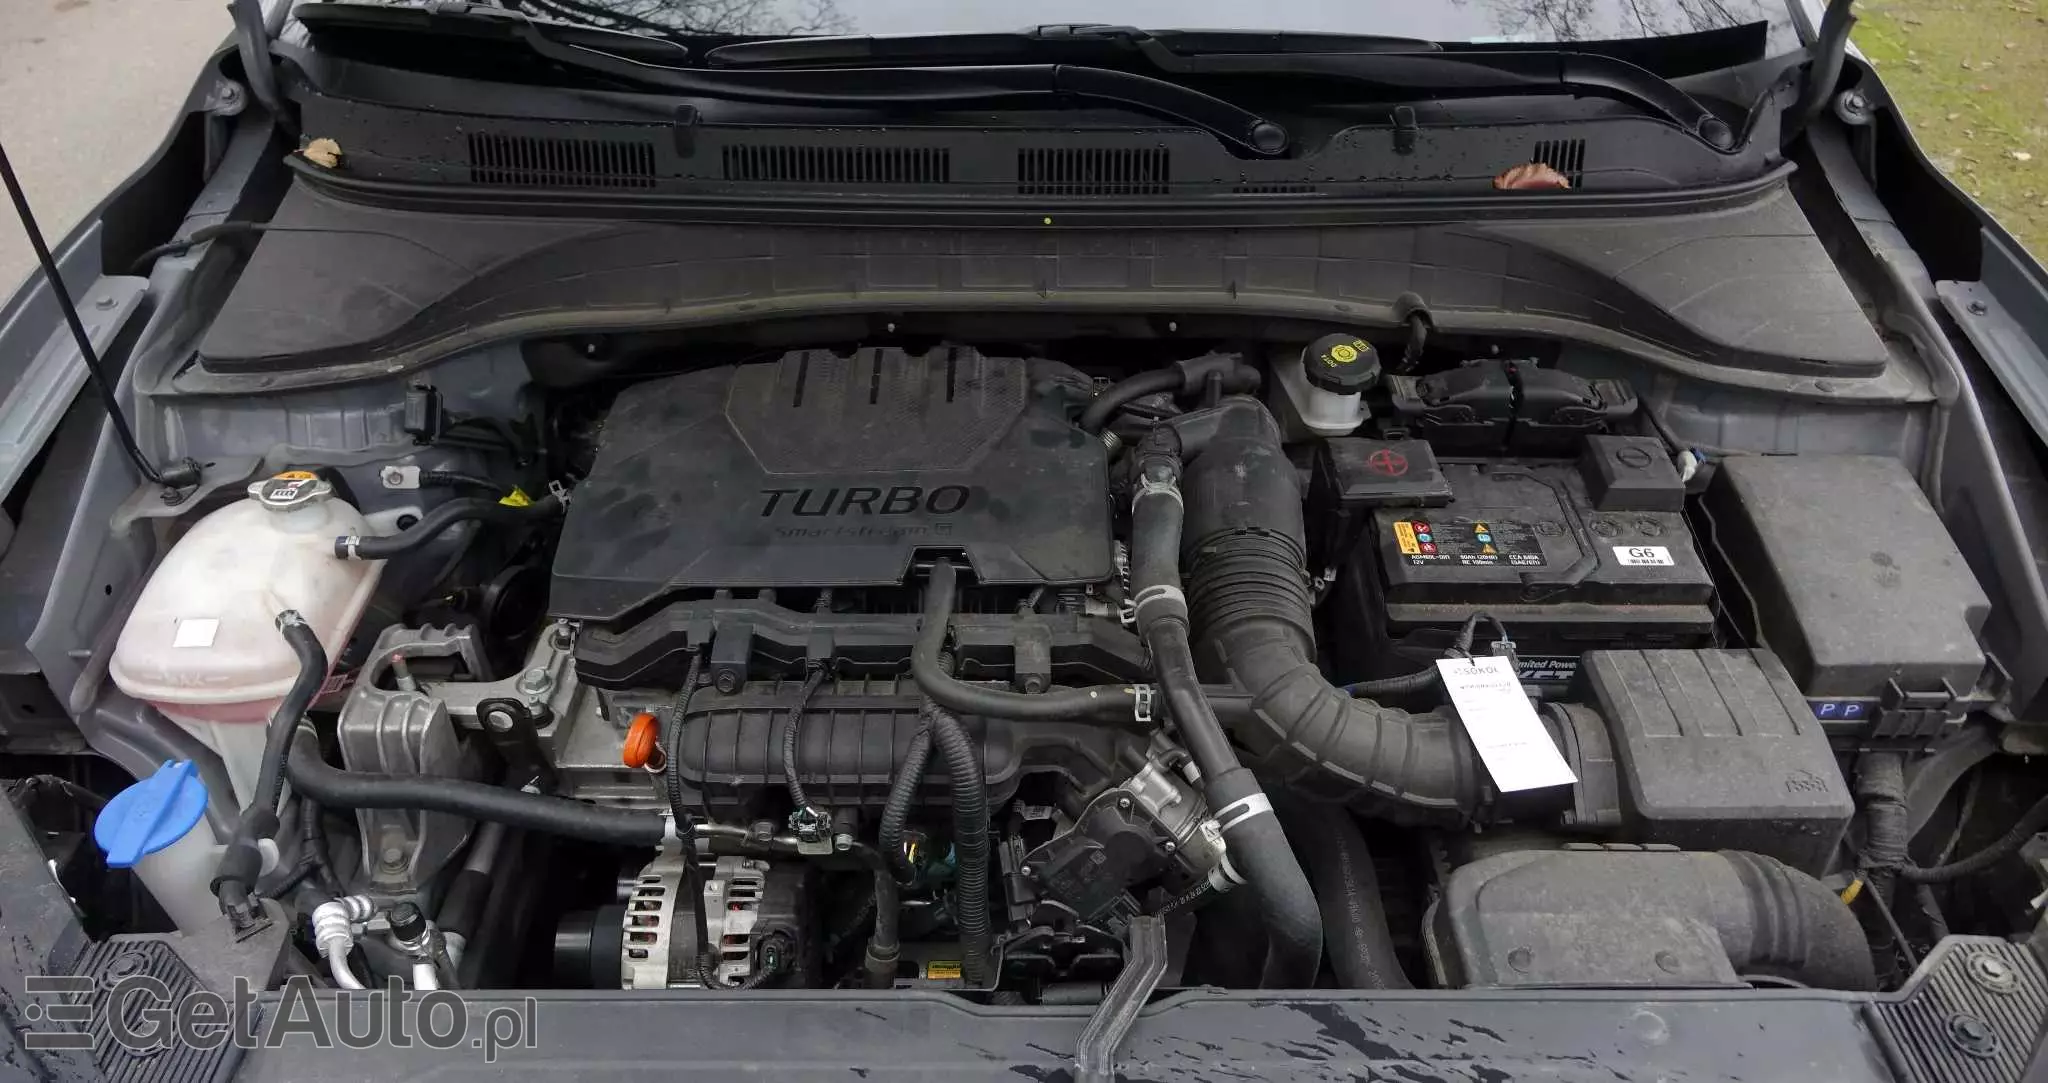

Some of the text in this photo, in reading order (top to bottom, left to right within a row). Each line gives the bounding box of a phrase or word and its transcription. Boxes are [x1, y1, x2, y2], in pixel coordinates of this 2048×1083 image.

[760, 485, 970, 517] TURBO
[1629, 547, 1655, 558] G6
[1549, 660, 1577, 669] Powe
[1820, 703, 1860, 716] P P
